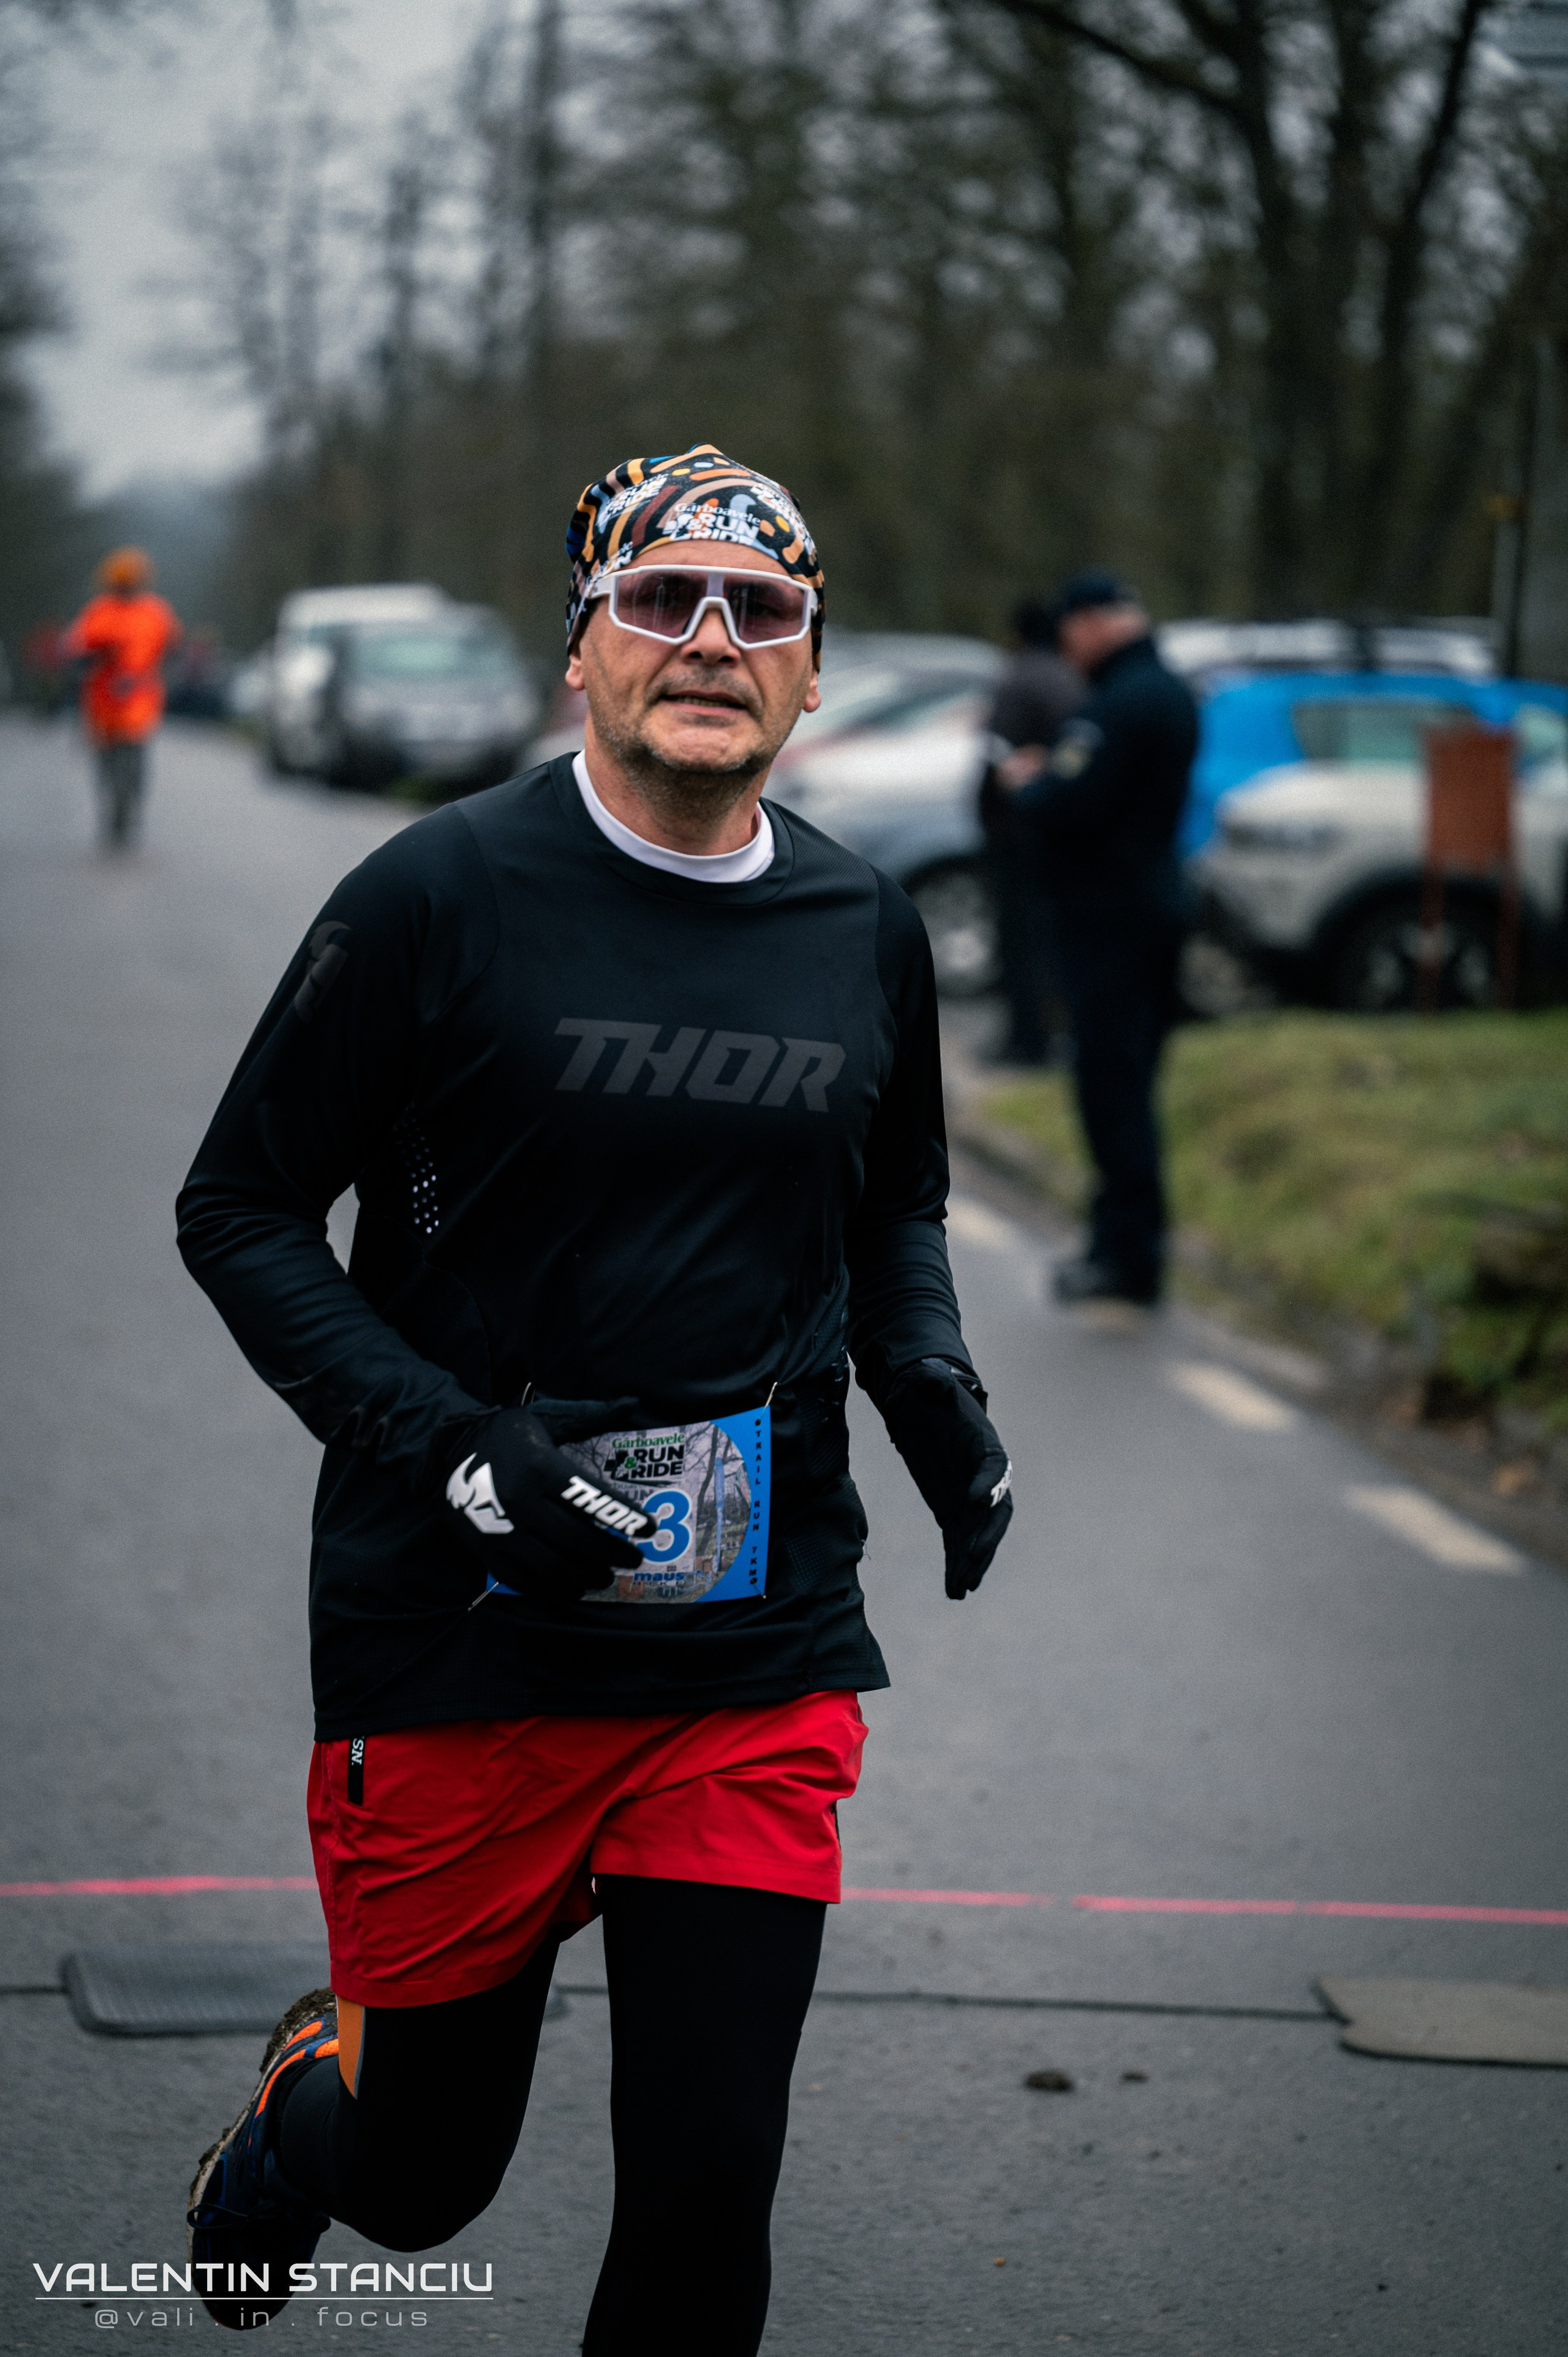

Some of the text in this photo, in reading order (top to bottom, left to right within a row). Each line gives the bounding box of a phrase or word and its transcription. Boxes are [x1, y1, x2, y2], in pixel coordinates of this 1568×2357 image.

[699, 513, 760, 539] RUN
[554, 1017, 846, 1113] THOR
[633, 1444, 685, 1463] RUN
[631, 1461, 683, 1478] RIDE
[562, 1476, 649, 1536] THOR
[633, 1572, 685, 1582] maus
